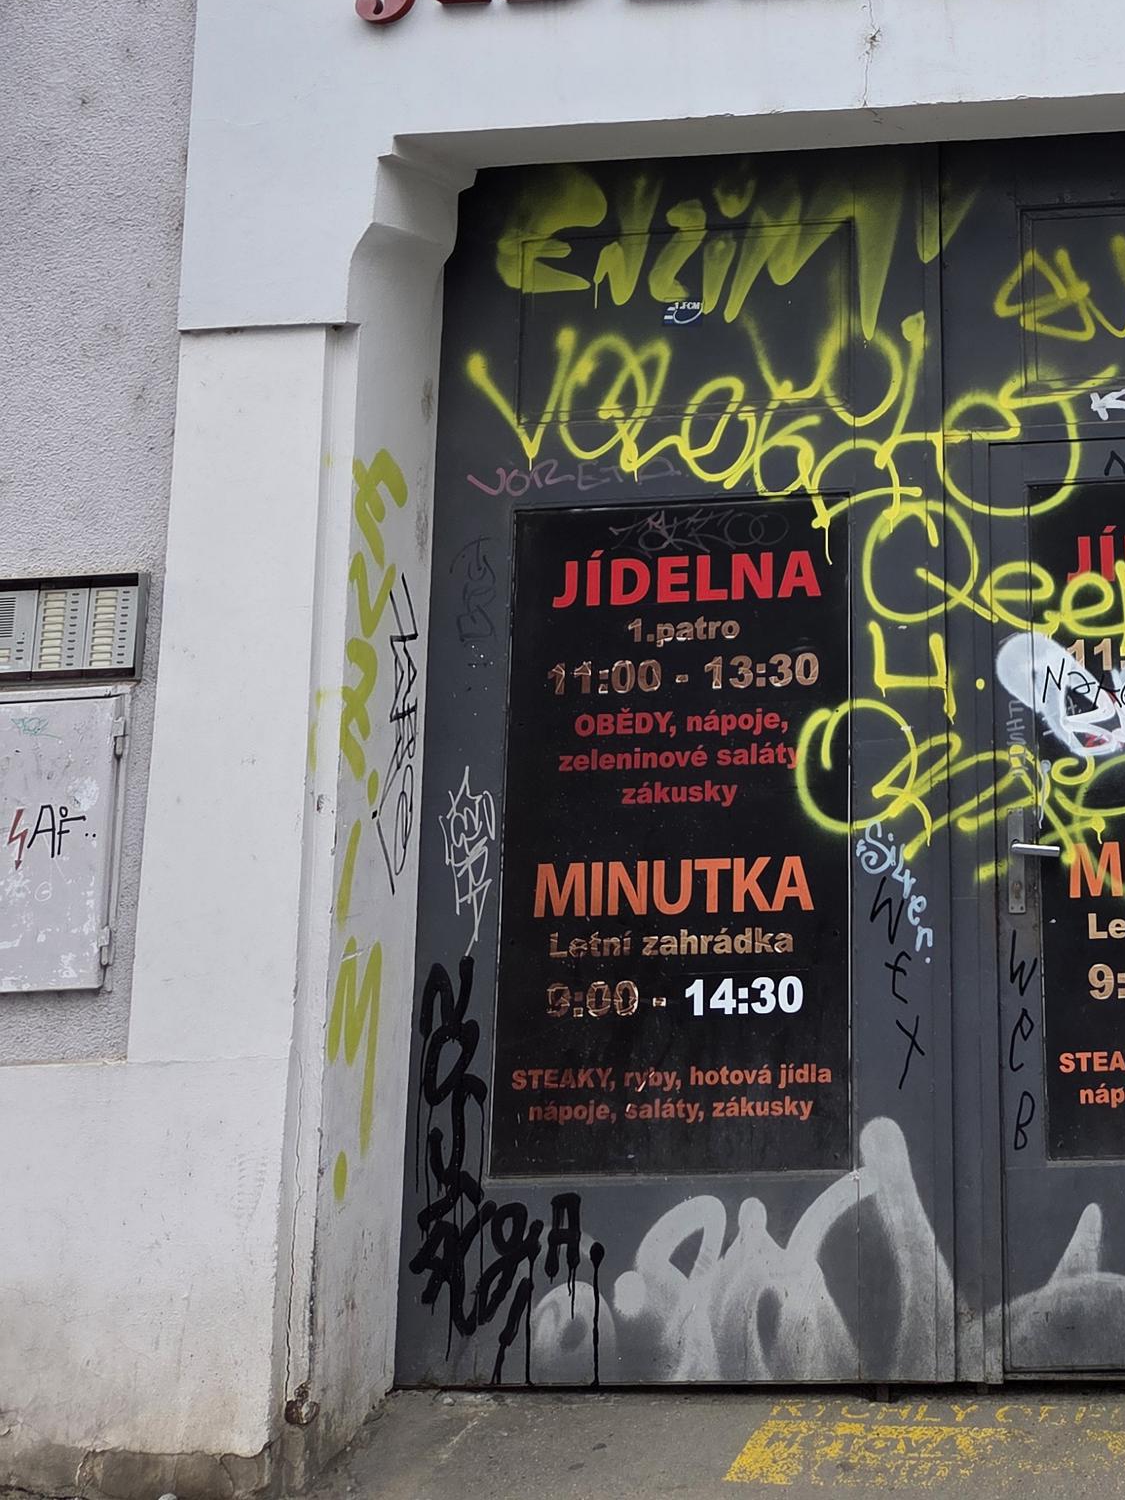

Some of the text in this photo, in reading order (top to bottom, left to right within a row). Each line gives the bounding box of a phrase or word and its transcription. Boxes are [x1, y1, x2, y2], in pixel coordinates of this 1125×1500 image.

[552, 550, 822, 609] JÍDELNA
[627, 614, 741, 648] 1.patro
[546, 658, 662, 696] 11:00
[704, 652, 821, 692] 13:30
[574, 708, 789, 739] OBĚDY, nápoje,
[558, 743, 707, 773] zeleninové
[621, 779, 739, 809] zákusky
[533, 856, 815, 919] MINUTKA
[549, 926, 794, 959] Letní zahrádka
[545, 979, 640, 1019] 9:00
[684, 974, 804, 1018] 14:30
[511, 1061, 832, 1092] STEAKY, ryby, hotová jídla
[528, 1096, 814, 1126] nápoje, saláty, zákusky
